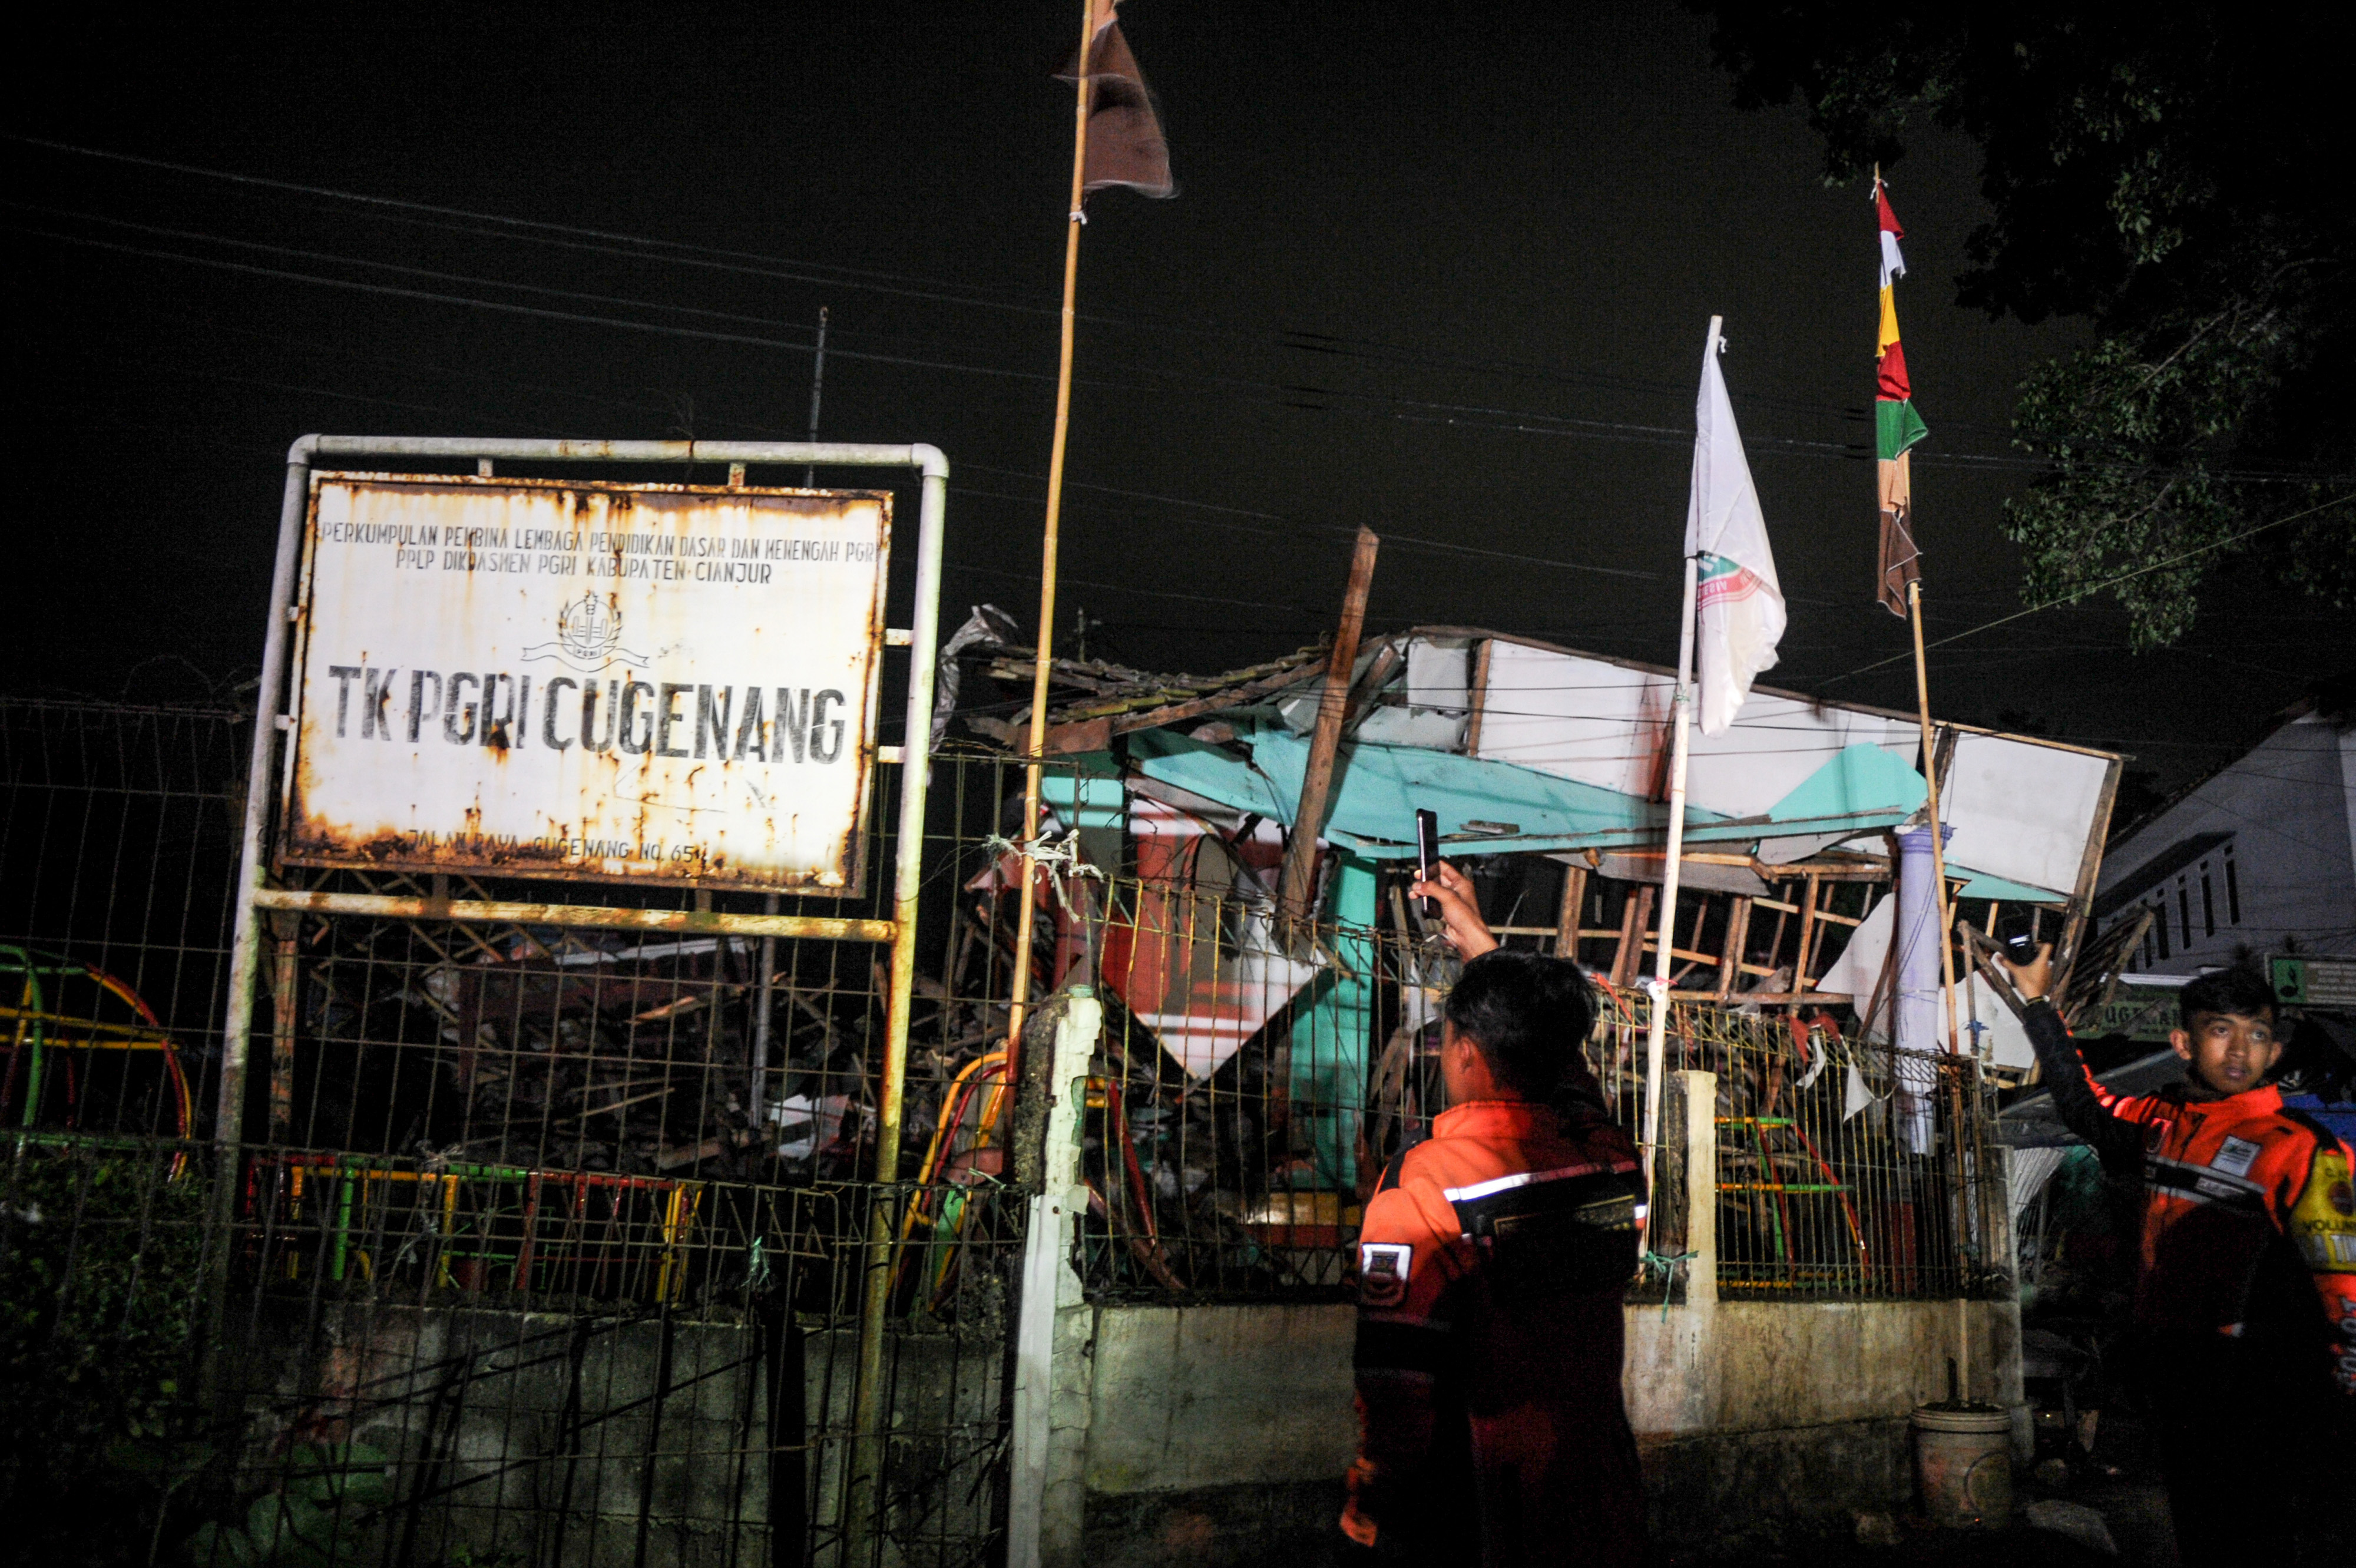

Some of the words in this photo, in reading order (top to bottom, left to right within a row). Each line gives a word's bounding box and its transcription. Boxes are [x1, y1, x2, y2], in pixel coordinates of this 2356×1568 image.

[322, 522, 438, 546] PERKUMPULAN
[444, 526, 508, 548] PEMBINA
[514, 529, 583, 551] LEMBAGA
[590, 531, 675, 556] PENDIDIKAN
[679, 536, 726, 558] DASAR
[732, 538, 760, 559] DAN
[765, 538, 840, 561] MENENGAH
[396, 549, 435, 570] PPLP
[443, 550, 530, 573] DIKDASMEN
[537, 554, 577, 575] PGRI
[585, 555, 686, 580] KABUPATEN
[695, 561, 772, 584] CIANJUR
[329, 666, 396, 742] TK
[406, 670, 531, 749] PGRI
[542, 677, 846, 765] CUGENANG
